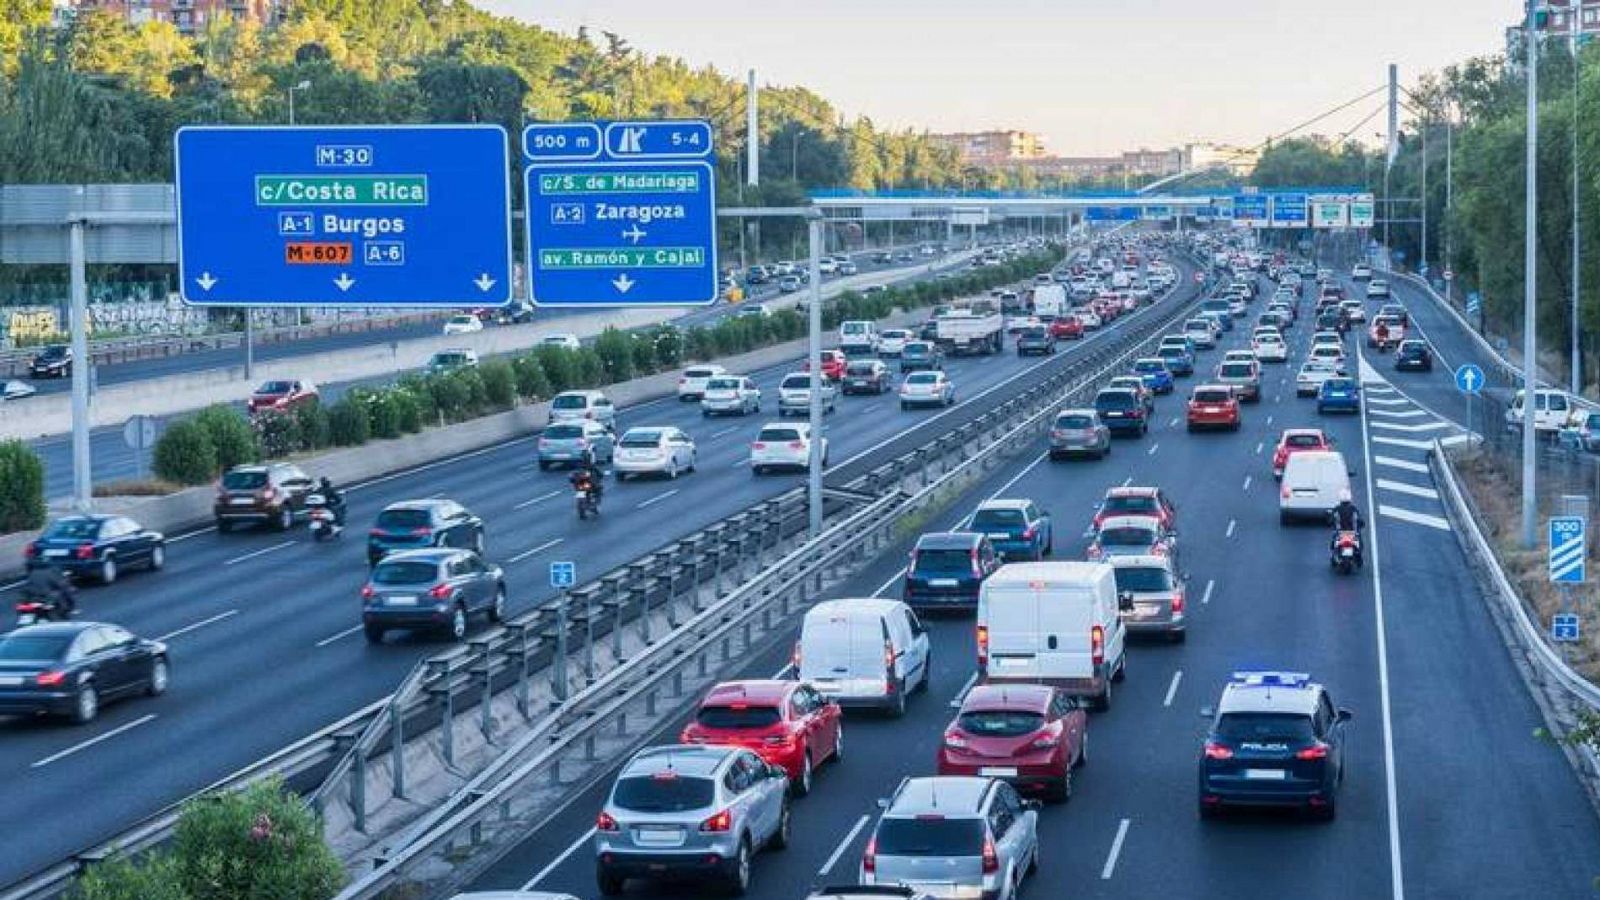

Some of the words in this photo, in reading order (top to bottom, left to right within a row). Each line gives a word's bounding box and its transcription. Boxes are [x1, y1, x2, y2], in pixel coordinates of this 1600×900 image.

[534, 135, 566, 148] 500
[576, 136, 589, 147] m
[672, 132, 699, 145] 5-4
[320, 148, 368, 164] M-30
[543, 176, 580, 190] c/S.
[585, 177, 605, 189] de
[612, 173, 696, 190] Madariaga
[260, 182, 357, 199] c/Costa
[372, 181, 423, 199] Rica
[555, 209, 581, 221] A-2
[596, 203, 685, 223] Zaragoza
[283, 216, 313, 231] A-1
[323, 215, 405, 237] Burgos
[287, 246, 349, 260] M-607
[368, 246, 400, 260] A-6
[544, 256, 567, 265] av.
[572, 250, 629, 265] Ramón
[636, 254, 645, 266] y
[655, 250, 700, 267] Cajal
[1553, 522, 1580, 531] 300
